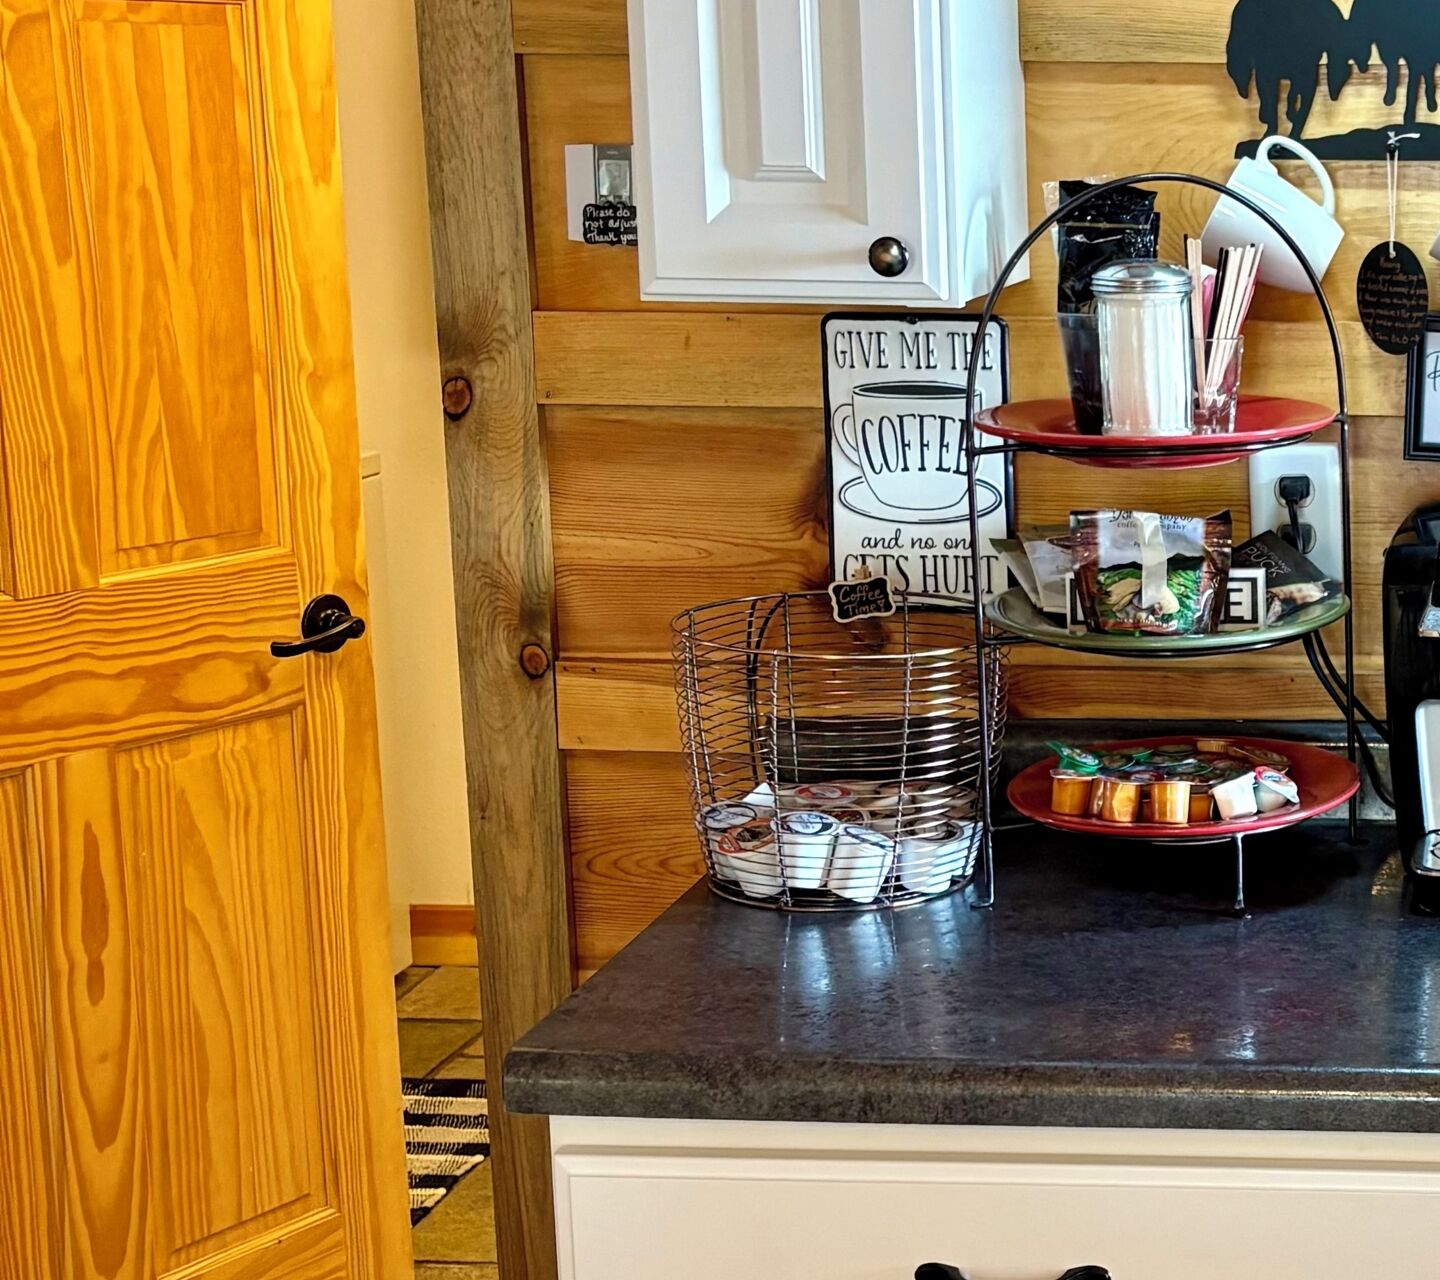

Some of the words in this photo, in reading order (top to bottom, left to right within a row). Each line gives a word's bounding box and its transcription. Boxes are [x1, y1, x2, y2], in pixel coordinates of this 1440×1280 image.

[585, 206, 614, 218] Please
[616, 205, 630, 217] do
[585, 220, 604, 229] not
[608, 219, 637, 231] adjus
[586, 231, 618, 243] Thank
[834, 331, 889, 369] GIVE
[900, 331, 938, 370] ME
[861, 528, 904, 550] and
[911, 537, 937, 550] no
[943, 537, 972, 550] on
[1244, 546, 1285, 577] PUCK
[839, 584, 884, 603] Coffee
[843, 599, 886, 616] Time!
